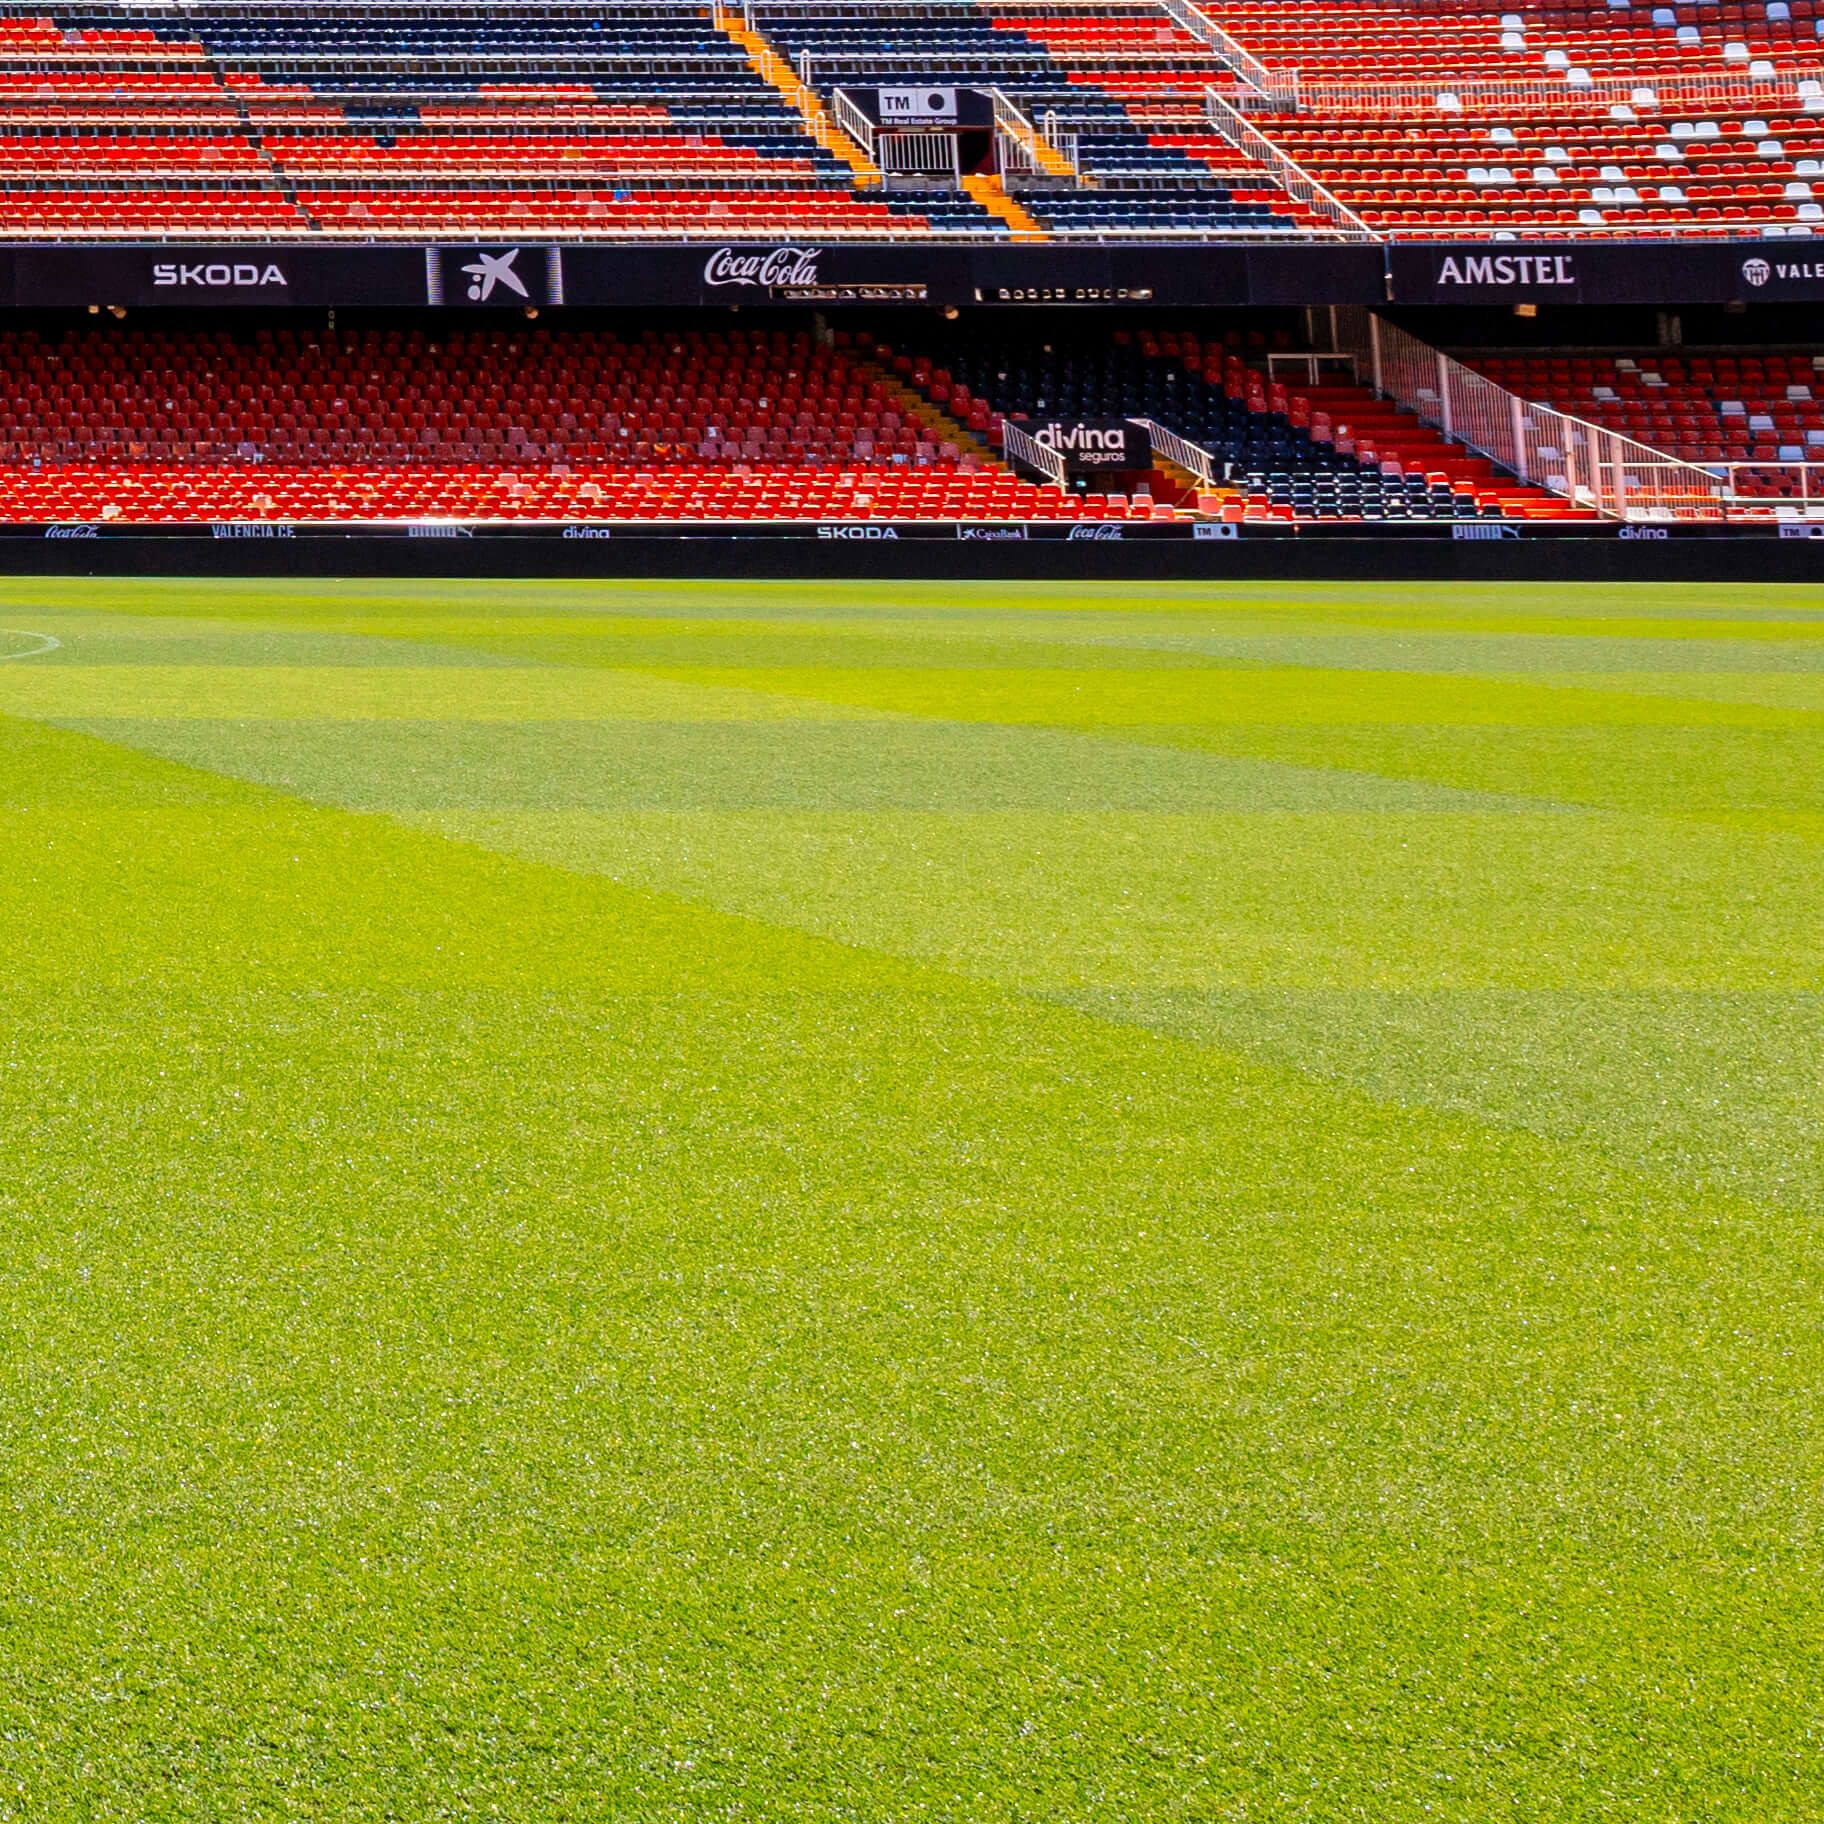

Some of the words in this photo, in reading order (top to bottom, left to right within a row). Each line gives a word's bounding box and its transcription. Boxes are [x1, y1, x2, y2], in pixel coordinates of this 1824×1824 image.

[884, 96, 909, 110] TM
[703, 247, 822, 286] Coca-Cola
[1437, 255, 1575, 285] AMSTEL
[1035, 423, 1125, 449] divina
[1079, 451, 1126, 464] seguros
[211, 525, 274, 537] VALENCIA
[562, 525, 610, 539] divina
[1197, 527, 1211, 537] TM
[1618, 525, 1669, 540] divina
